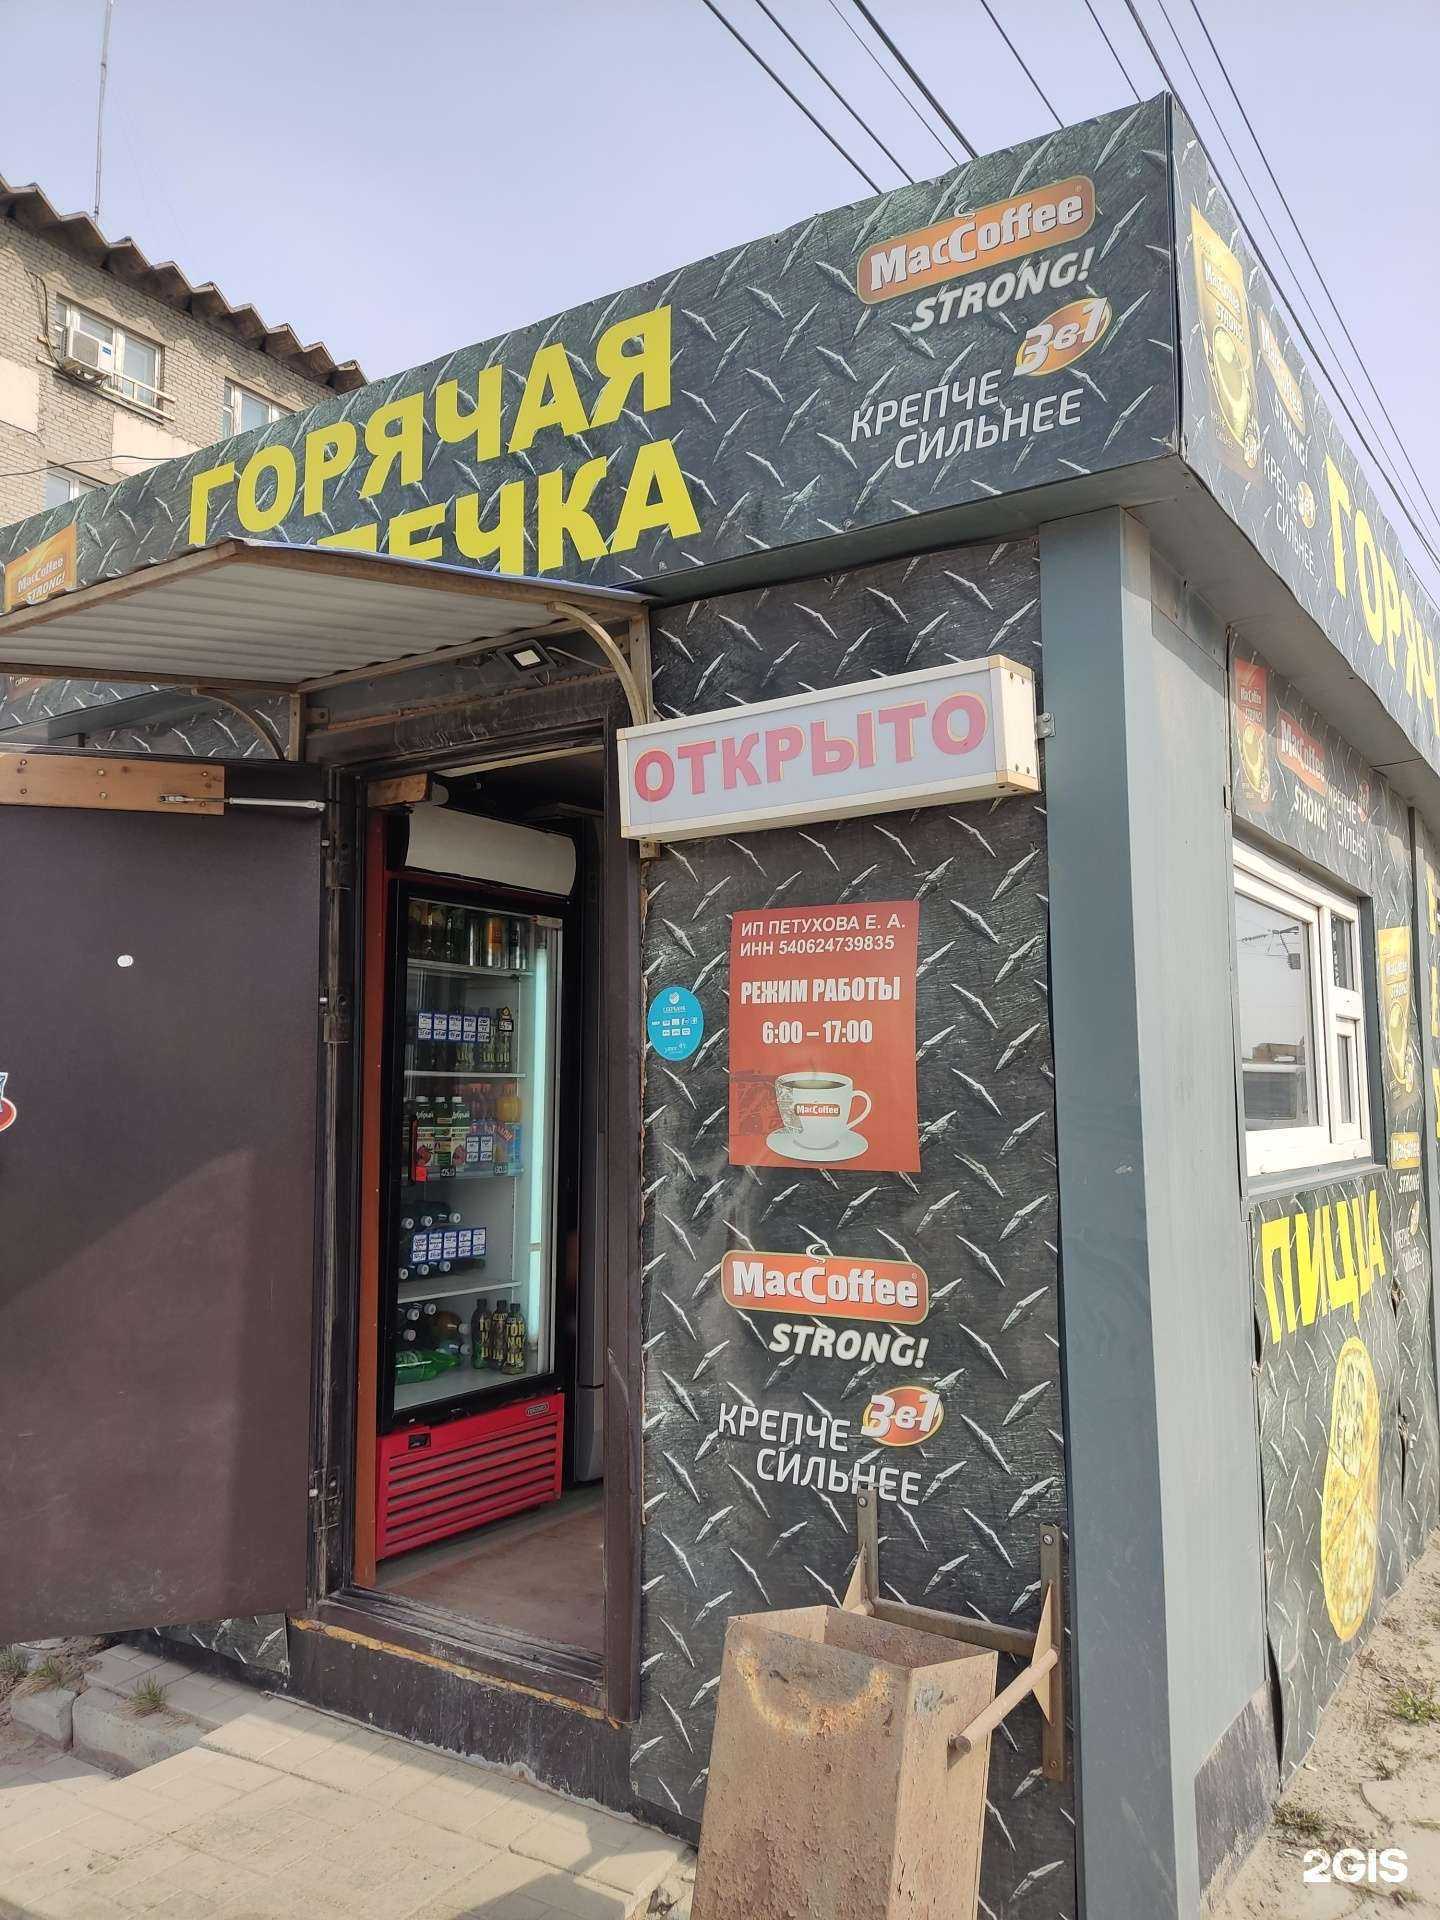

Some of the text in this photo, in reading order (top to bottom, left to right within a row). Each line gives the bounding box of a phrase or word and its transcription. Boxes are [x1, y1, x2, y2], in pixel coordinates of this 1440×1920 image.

[870, 195, 1084, 291] MacCoffee
[911, 247, 1095, 332] STRONG!
[189, 305, 672, 544] ГОРЯЧАЯ
[851, 369, 1002, 442] КРЕПЧЕ
[894, 388, 1084, 469] СИЛЬНЕЕ
[317, 438, 701, 576] ЕЧКА
[634, 690, 989, 802] ОТКРЫТО
[740, 935, 895, 957] ИНН 540624739835
[741, 913, 905, 936] ИП ПЕТУХОВА Е. А.
[740, 976, 900, 1004] РЕЖИМ РАБОТЫ
[762, 1021, 803, 1043] 6:00
[822, 1019, 873, 1043] 17:00
[796, 1103, 839, 1116] MacCoffee
[732, 1261, 919, 1307] MacCoffee
[769, 1323, 929, 1369] STRONG!
[718, 1402, 850, 1452] КРЕПЧЕ
[756, 1448, 922, 1506] СИЛЬНЕЕ
